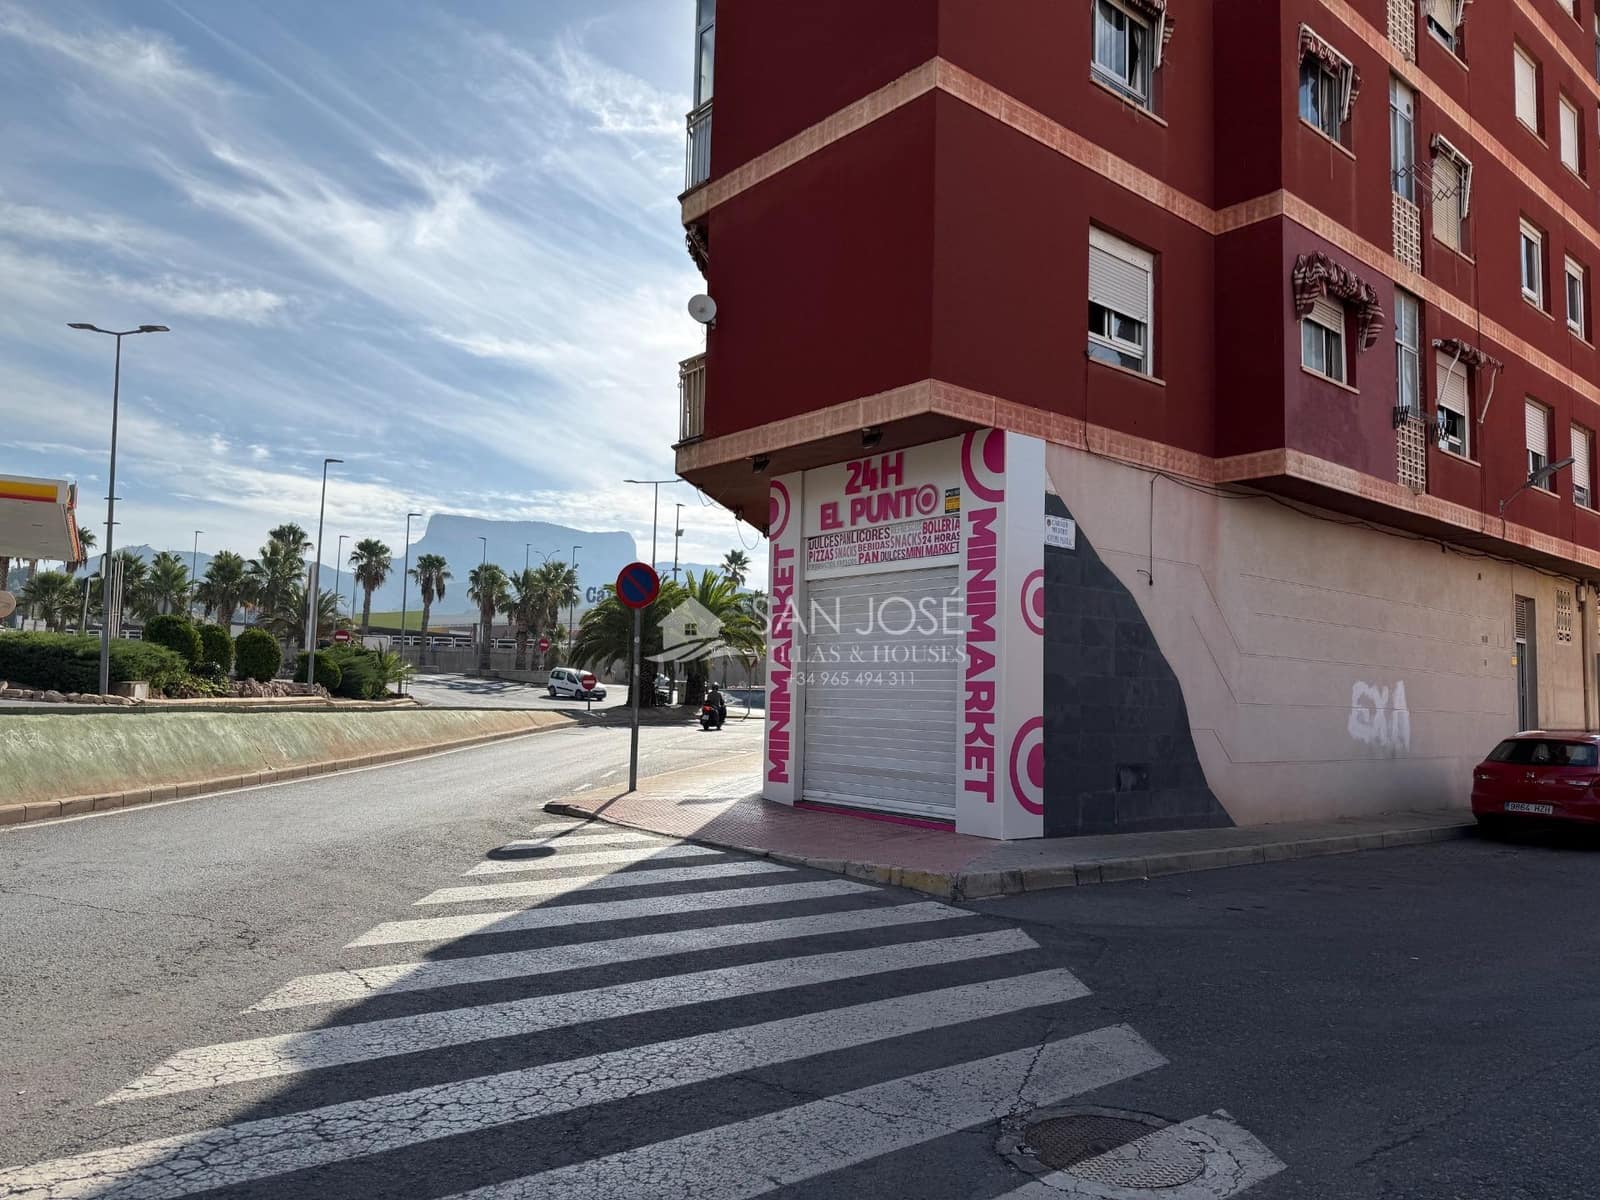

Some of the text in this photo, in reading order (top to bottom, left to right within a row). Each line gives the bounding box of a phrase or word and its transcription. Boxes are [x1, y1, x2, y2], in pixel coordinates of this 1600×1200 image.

[845, 451, 904, 495] 24H
[820, 502, 844, 531] EL
[850, 484, 938, 526] PUNTO
[808, 534, 840, 550] DULCES
[851, 527, 890, 544] LICORES
[808, 549, 834, 563] PIZZAS
[858, 540, 890, 553] BEBIDAS
[890, 532, 922, 549] SNACKS
[922, 535, 932, 545] 24
[934, 531, 960, 543] HORAS
[858, 551, 880, 565] PAN
[880, 549, 906, 562] DULCES
[905, 545, 924, 559] MINI
[925, 541, 960, 556] MARKET
[768, 544, 795, 784] MINIMARKET
[964, 507, 998, 803] MINIMARKET
